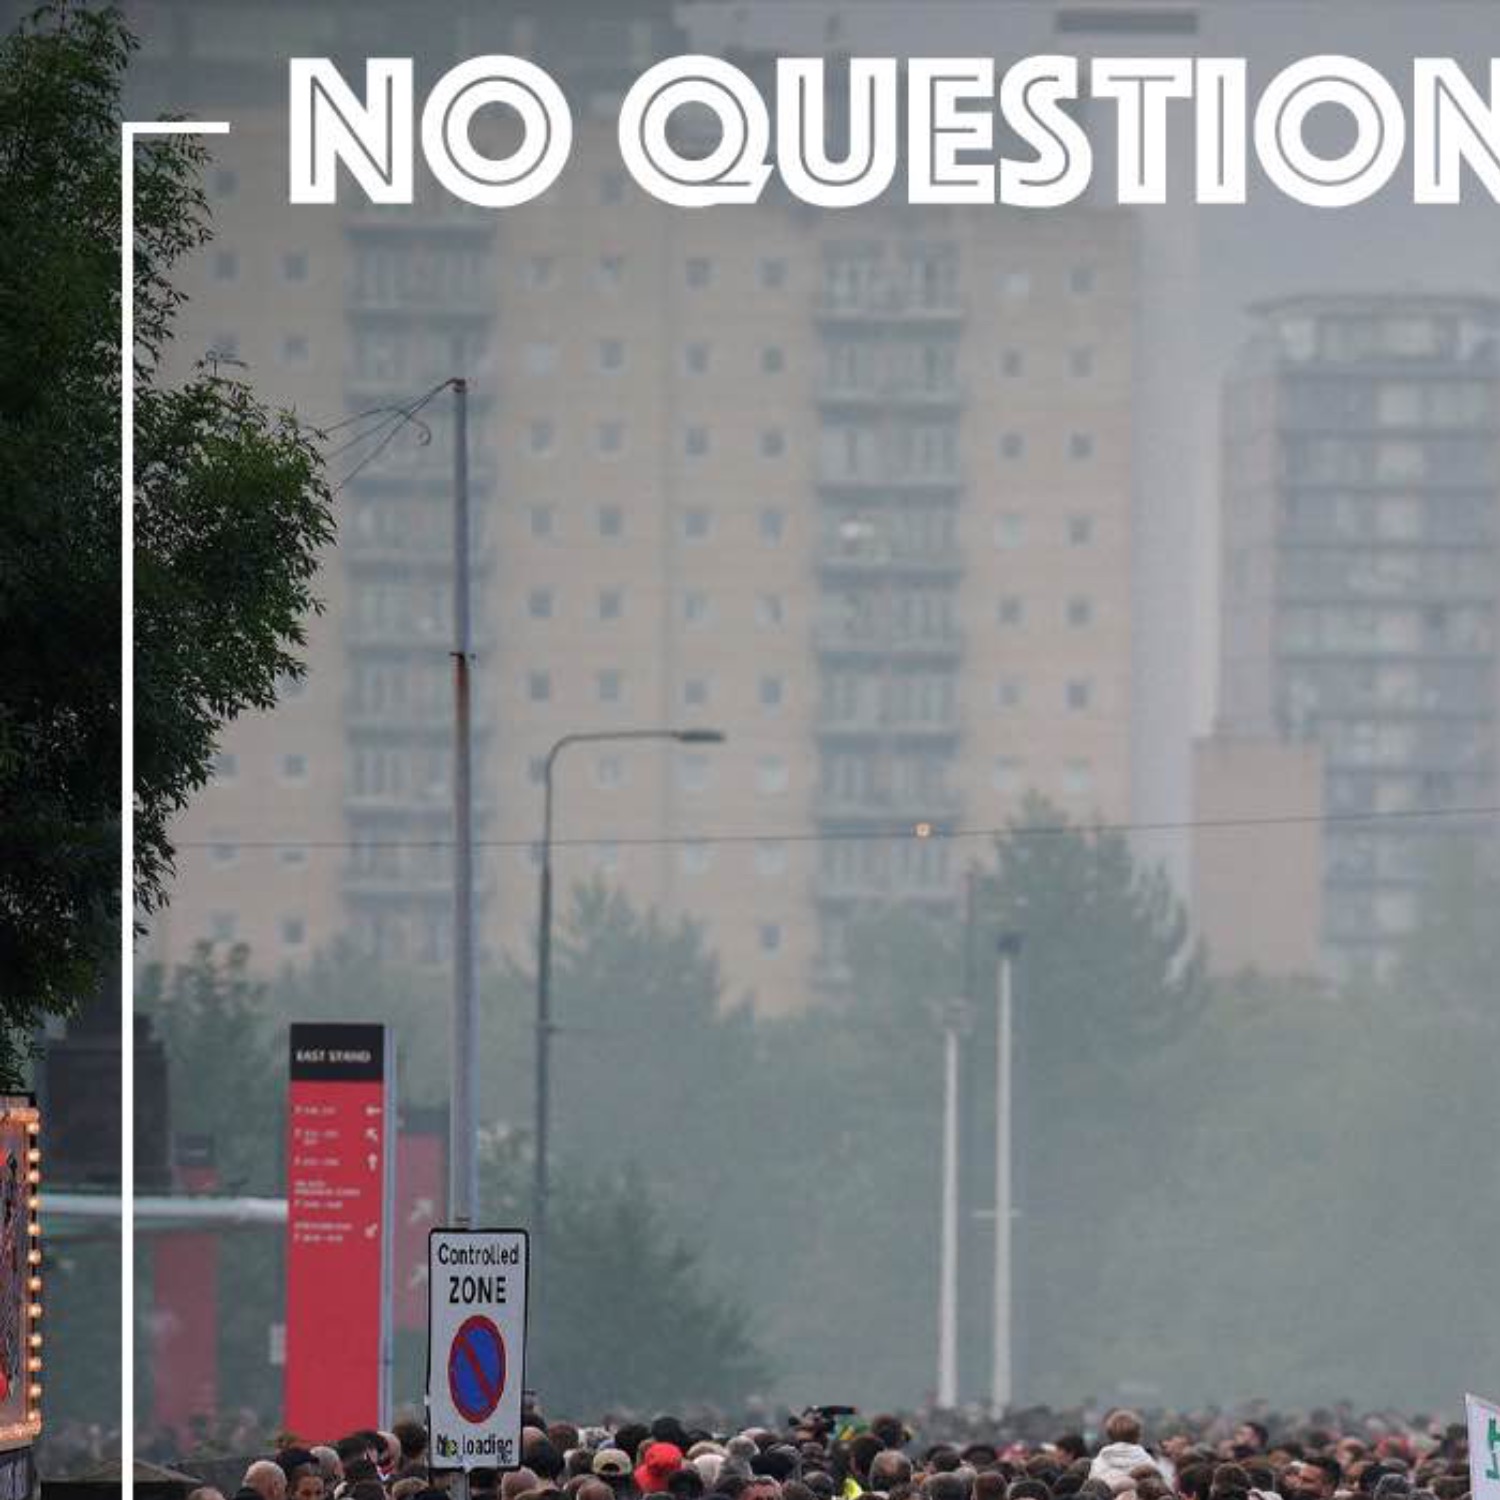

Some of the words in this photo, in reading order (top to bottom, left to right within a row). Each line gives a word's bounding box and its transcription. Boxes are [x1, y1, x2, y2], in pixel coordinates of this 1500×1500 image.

[296, 1050, 325, 1062] EAST
[328, 1050, 372, 1062] STAND
[438, 1243, 519, 1265] Controlled
[449, 1277, 507, 1304] ZONE
[462, 1434, 513, 1457] loading
